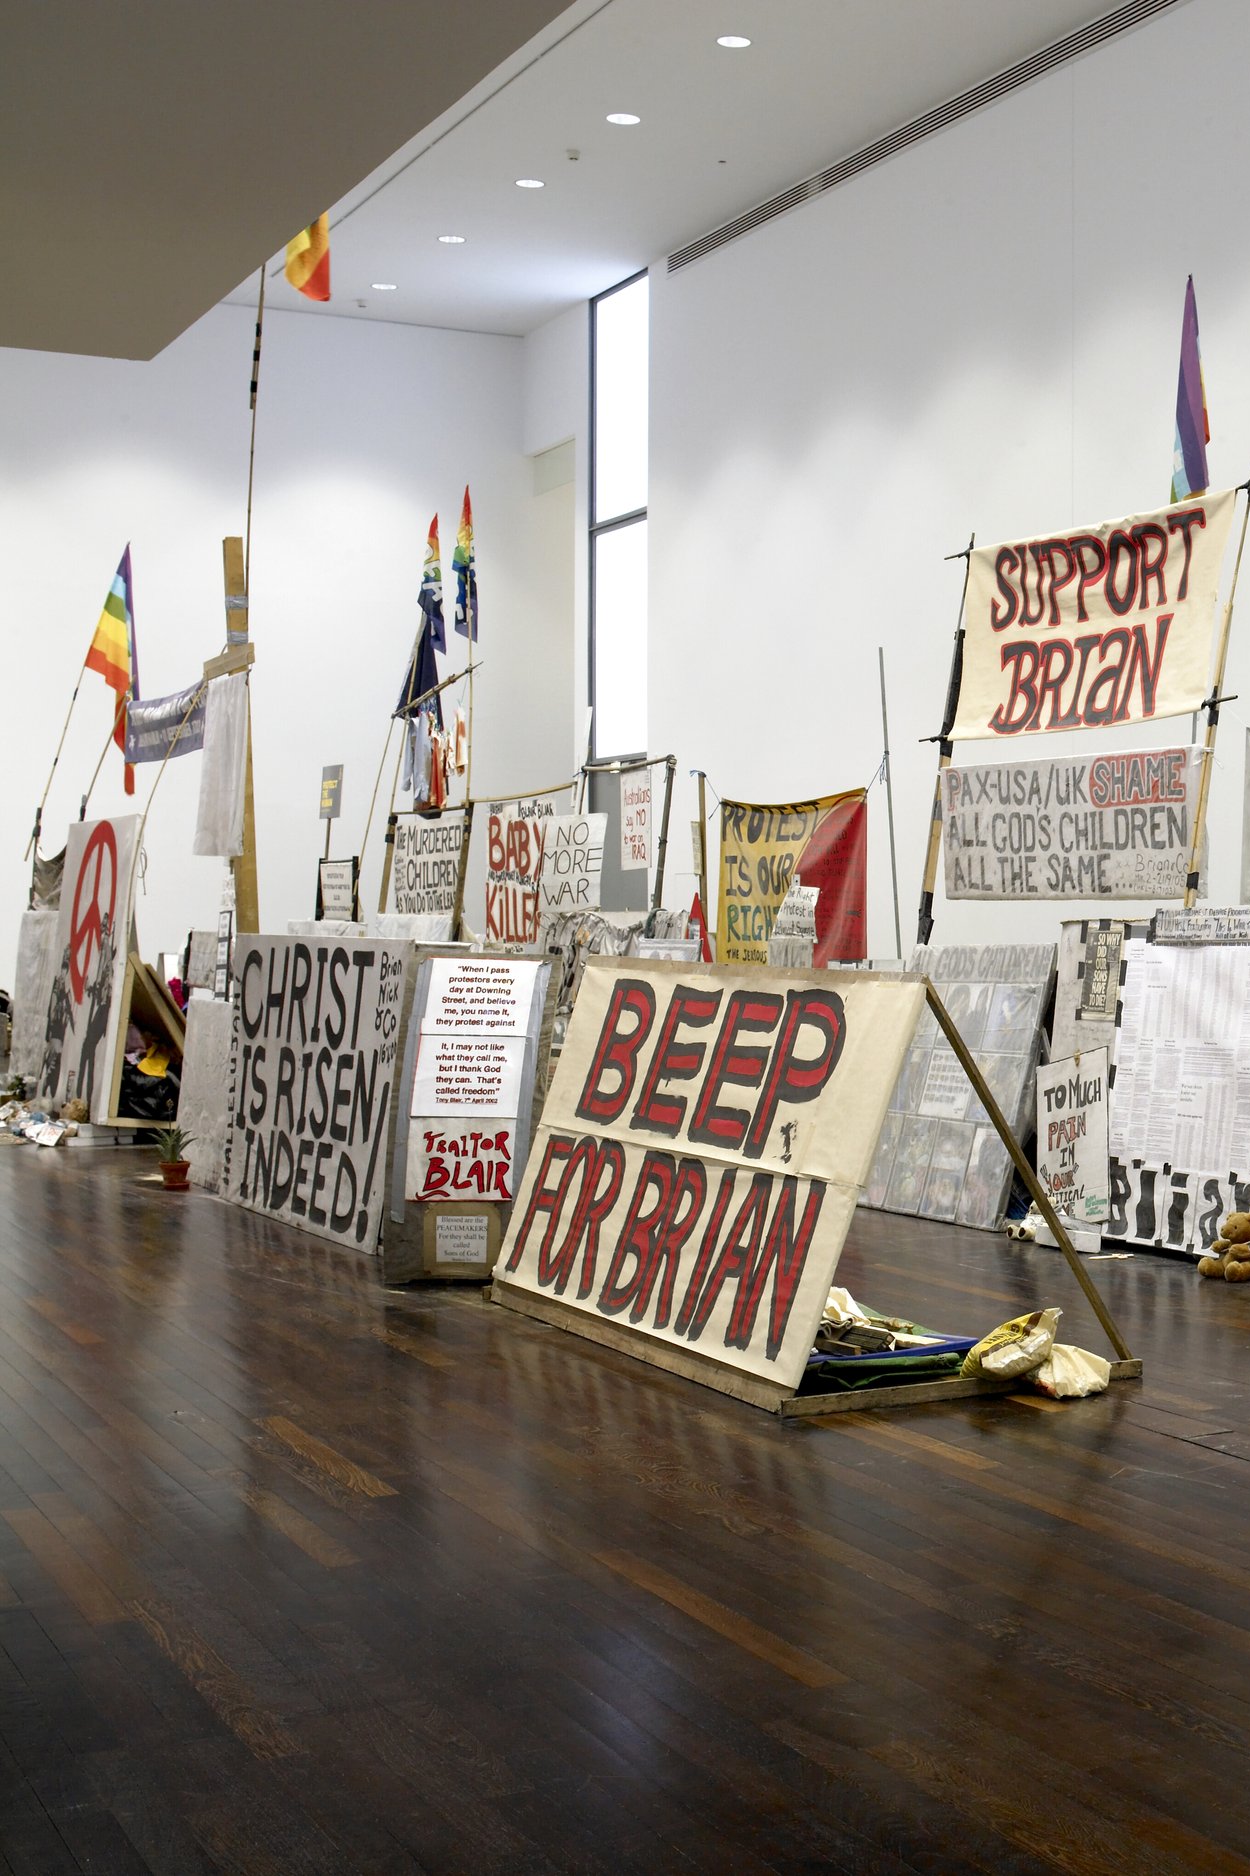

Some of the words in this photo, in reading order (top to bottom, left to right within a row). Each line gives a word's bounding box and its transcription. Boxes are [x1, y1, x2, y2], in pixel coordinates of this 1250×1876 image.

[991, 507, 1206, 632] SUPPORT
[1092, 755, 1185, 803] SHAME
[636, 809, 647, 827] NO
[722, 801, 820, 844] PROTEST
[556, 822, 589, 846] NO
[949, 812, 987, 848] ALL
[1059, 805, 1187, 854] CHILDREN
[406, 824, 461, 857] MURDERED
[488, 815, 547, 883] BABY
[541, 847, 603, 877] MORE
[631, 843, 647, 862] IRAQ
[406, 859, 461, 892] CHILDREN
[725, 855, 752, 897] IS
[757, 853, 795, 896] OUR
[953, 855, 993, 892] ALL
[997, 855, 1038, 894] THE
[542, 878, 590, 906] WAR
[1107, 933, 1121, 946] WHY
[727, 949, 739, 960] THE
[1097, 946, 1107, 958] DID
[380, 951, 402, 982] Brian
[486, 966, 489, 974] I
[490, 967, 510, 976] pass
[1095, 958, 1107, 970] OUR
[449, 976, 490, 985] protestors
[492, 977, 515, 985] every
[1093, 970, 1108, 982] SONS
[240, 942, 375, 1051] CHRIST
[449, 986, 464, 994] day
[465, 986, 474, 994] at
[476, 986, 511, 996] Downing
[1091, 982, 1106, 994] HAVE
[441, 996, 468, 1005] Street,
[469, 997, 485, 1005] and
[486, 997, 516, 1006] believe
[435, 1018, 453, 1027] they
[454, 1019, 484, 1027] protest
[485, 1019, 516, 1028] against
[460, 1009, 476, 1017] you
[450, 1042, 454, 1050] I
[455, 1043, 473, 1052] may
[474, 1043, 489, 1051] not
[489, 1043, 505, 1051] like
[435, 1054, 455, 1062] what
[456, 1054, 474, 1063] they
[476, 1054, 491, 1062] call
[492, 1055, 508, 1063] me,
[438, 1065, 453, 1073] but
[459, 1065, 482, 1073] thank
[483, 1065, 501, 1073] God
[575, 978, 848, 1160] BEEP
[435, 1076, 453, 1084] they
[236, 1044, 267, 1130] IS
[274, 1045, 378, 1147] RISEN
[435, 1087, 460, 1095] called
[435, 1097, 448, 1105] Tony
[1044, 1084, 1067, 1113] TO
[1068, 1073, 1101, 1110] MUCH
[1048, 1112, 1087, 1152] PAIN
[423, 1131, 511, 1161] TRAITOR
[1059, 1142, 1075, 1168] IN
[239, 1081, 390, 1243] INDEED!
[422, 1156, 512, 1199] BLAIR
[436, 1224, 488, 1232] PEACEMAKERS
[450, 1233, 462, 1241] they
[452, 1241, 470, 1249] called
[505, 1134, 627, 1301] FOR
[596, 1149, 828, 1362] BRIAN
